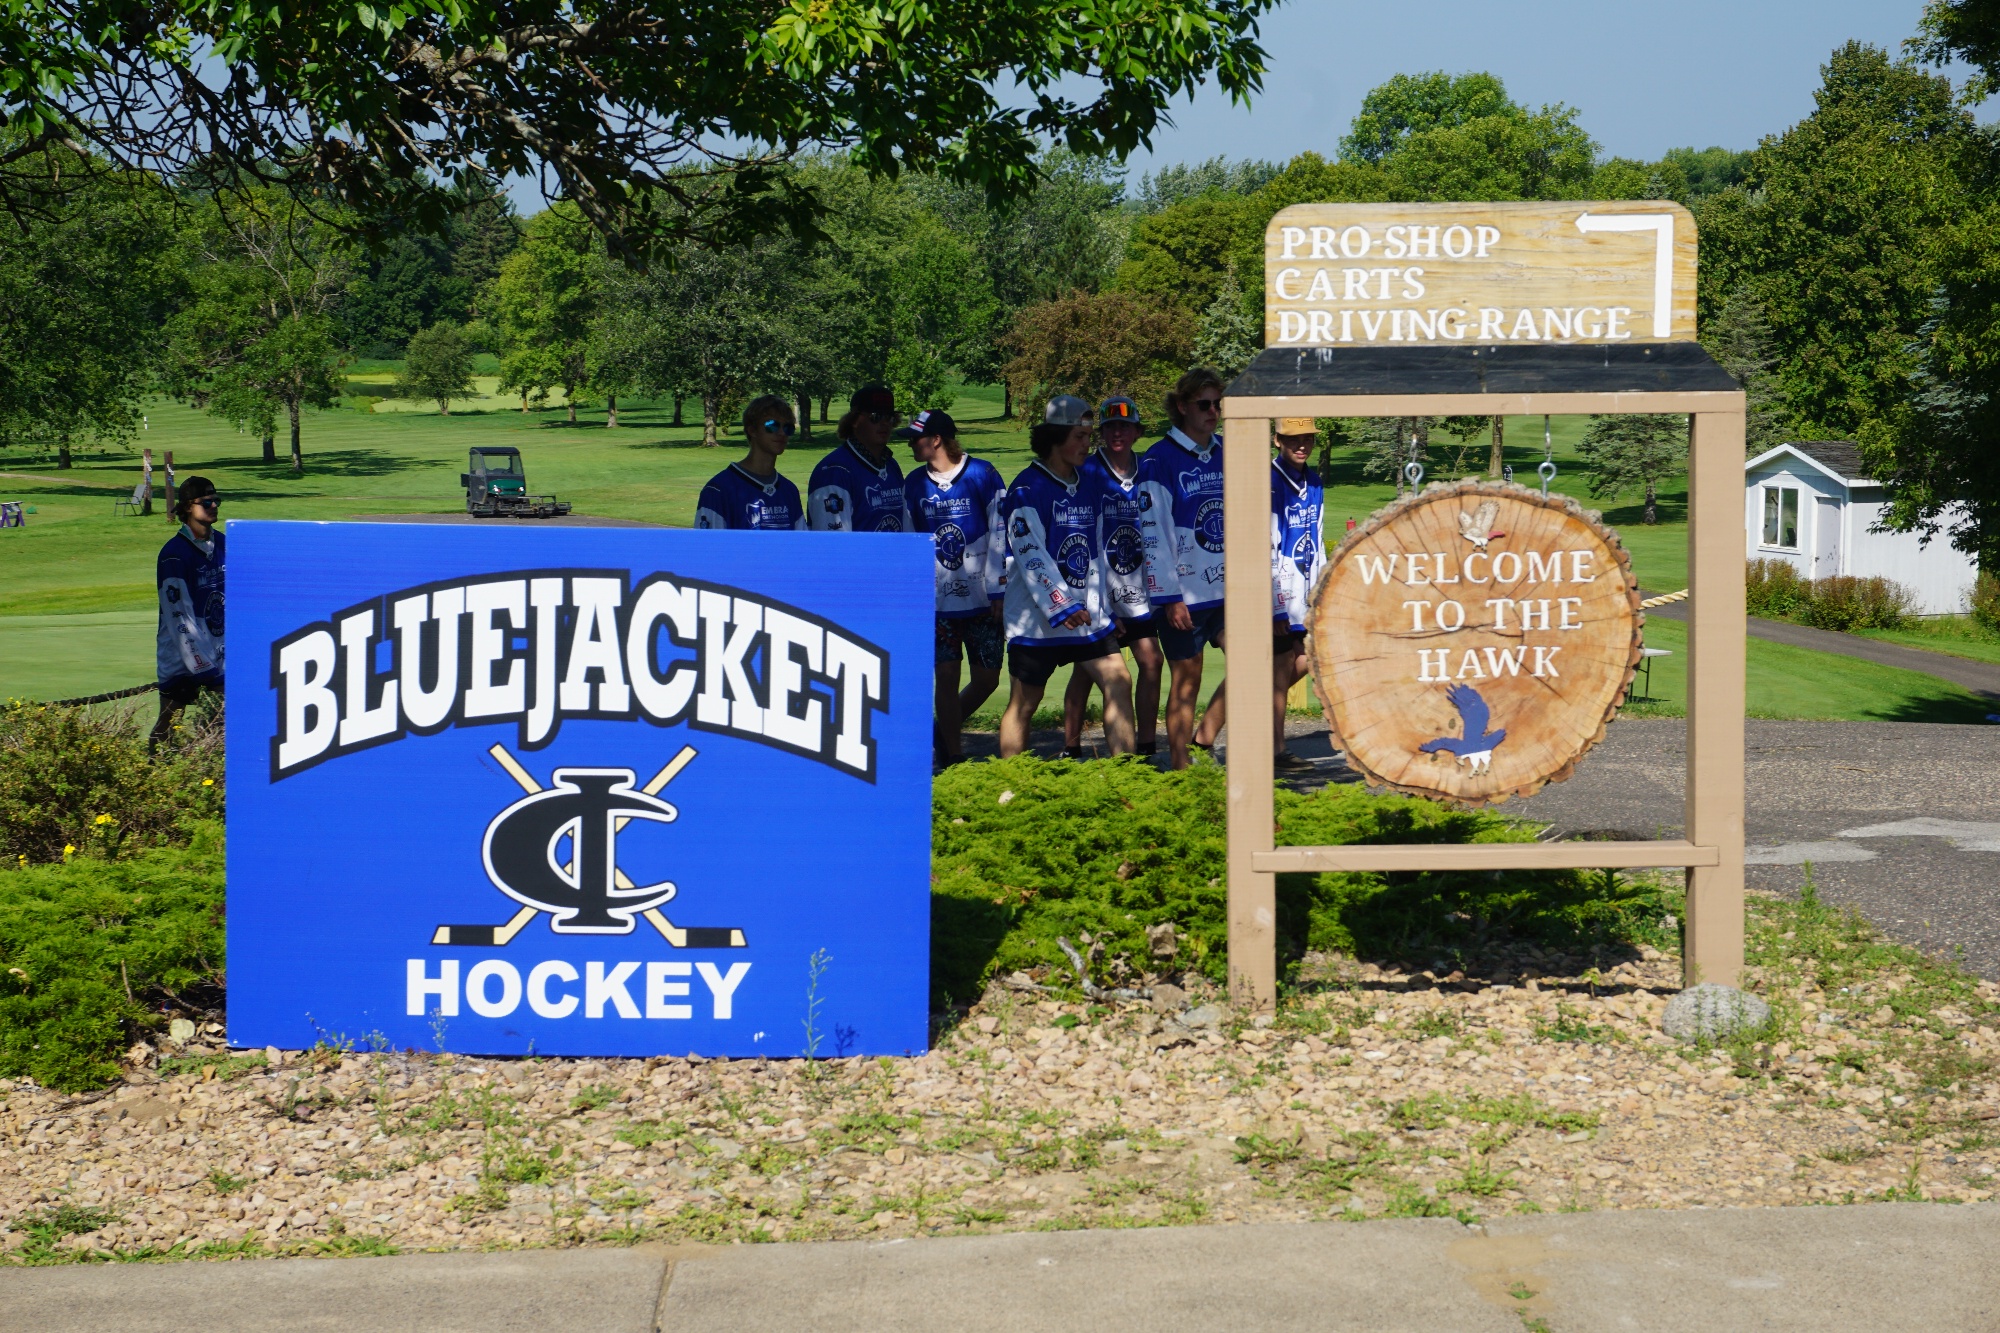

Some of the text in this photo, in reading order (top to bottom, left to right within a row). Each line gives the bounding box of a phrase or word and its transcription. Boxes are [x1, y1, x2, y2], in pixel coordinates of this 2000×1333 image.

[1280, 225, 1500, 259] PRO-SHOP
[1275, 267, 1425, 301] CARTS
[1277, 307, 1631, 343] DRIVING-RANGE
[1355, 550, 1595, 585] WELCOME
[1403, 597, 1583, 632] TO THE
[274, 573, 885, 777] BLUEJACKET
[1418, 645, 1561, 682] HAWK
[405, 959, 752, 1020] HOCKEY
